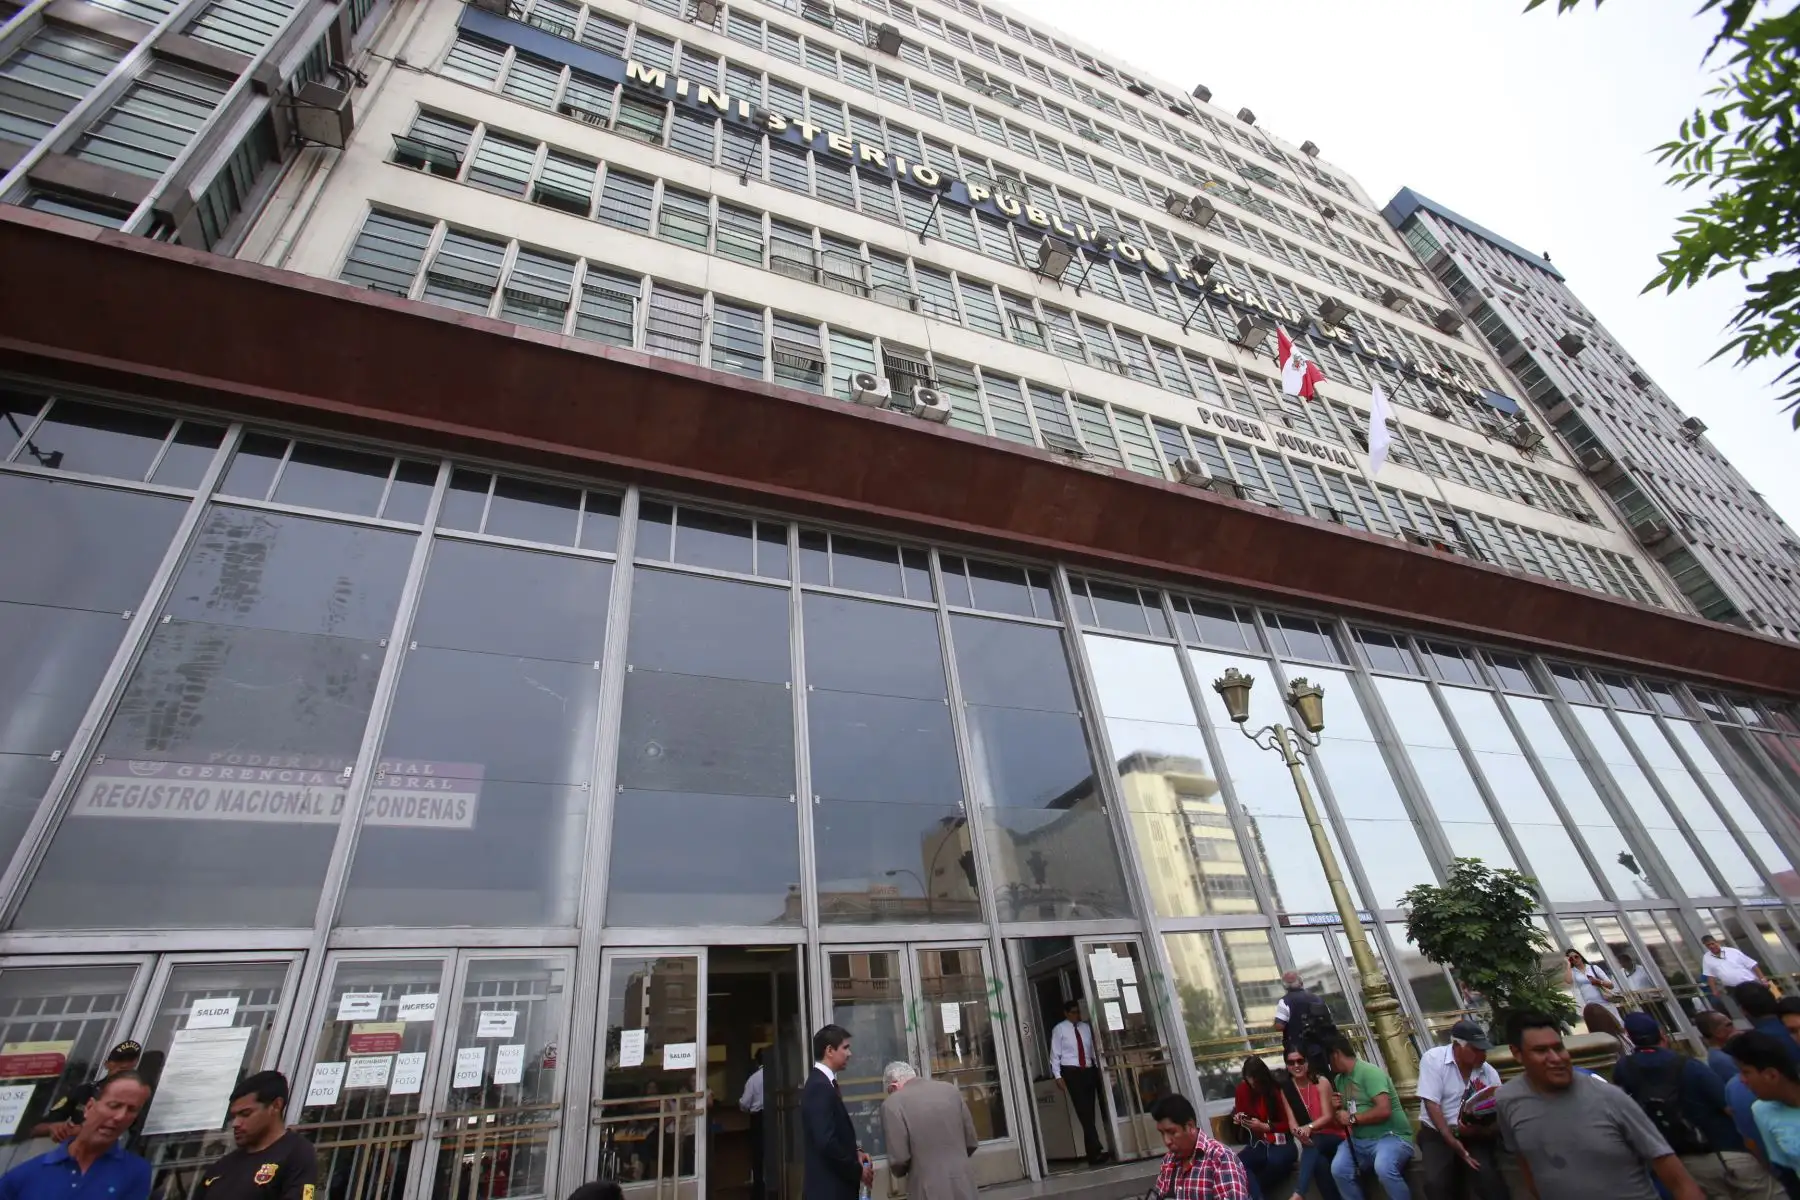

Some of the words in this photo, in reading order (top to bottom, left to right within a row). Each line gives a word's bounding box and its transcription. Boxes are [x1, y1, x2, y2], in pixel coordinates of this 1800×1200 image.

[625, 60, 940, 188] MINISTERIO
[1197, 406, 1266, 442] PODER
[1275, 431, 1357, 470] JUDICIAL
[209, 752, 301, 769] PODER
[177, 766, 323, 785] GERENCIA
[88, 783, 210, 811] REGISTRO
[329, 794, 347, 817] D
[365, 794, 468, 821] CONDENAS
[402, 1002, 436, 1011] INGRESO
[196, 1007, 230, 1017] SALIDA
[669, 1052, 691, 1060] SALIDA
[315, 1067, 328, 1076] NO
[330, 1066, 340, 1075] SE
[457, 1070, 478, 1079] FOTO
[13, 1090, 28, 1100] SE
[310, 1087, 334, 1097] FOTO
